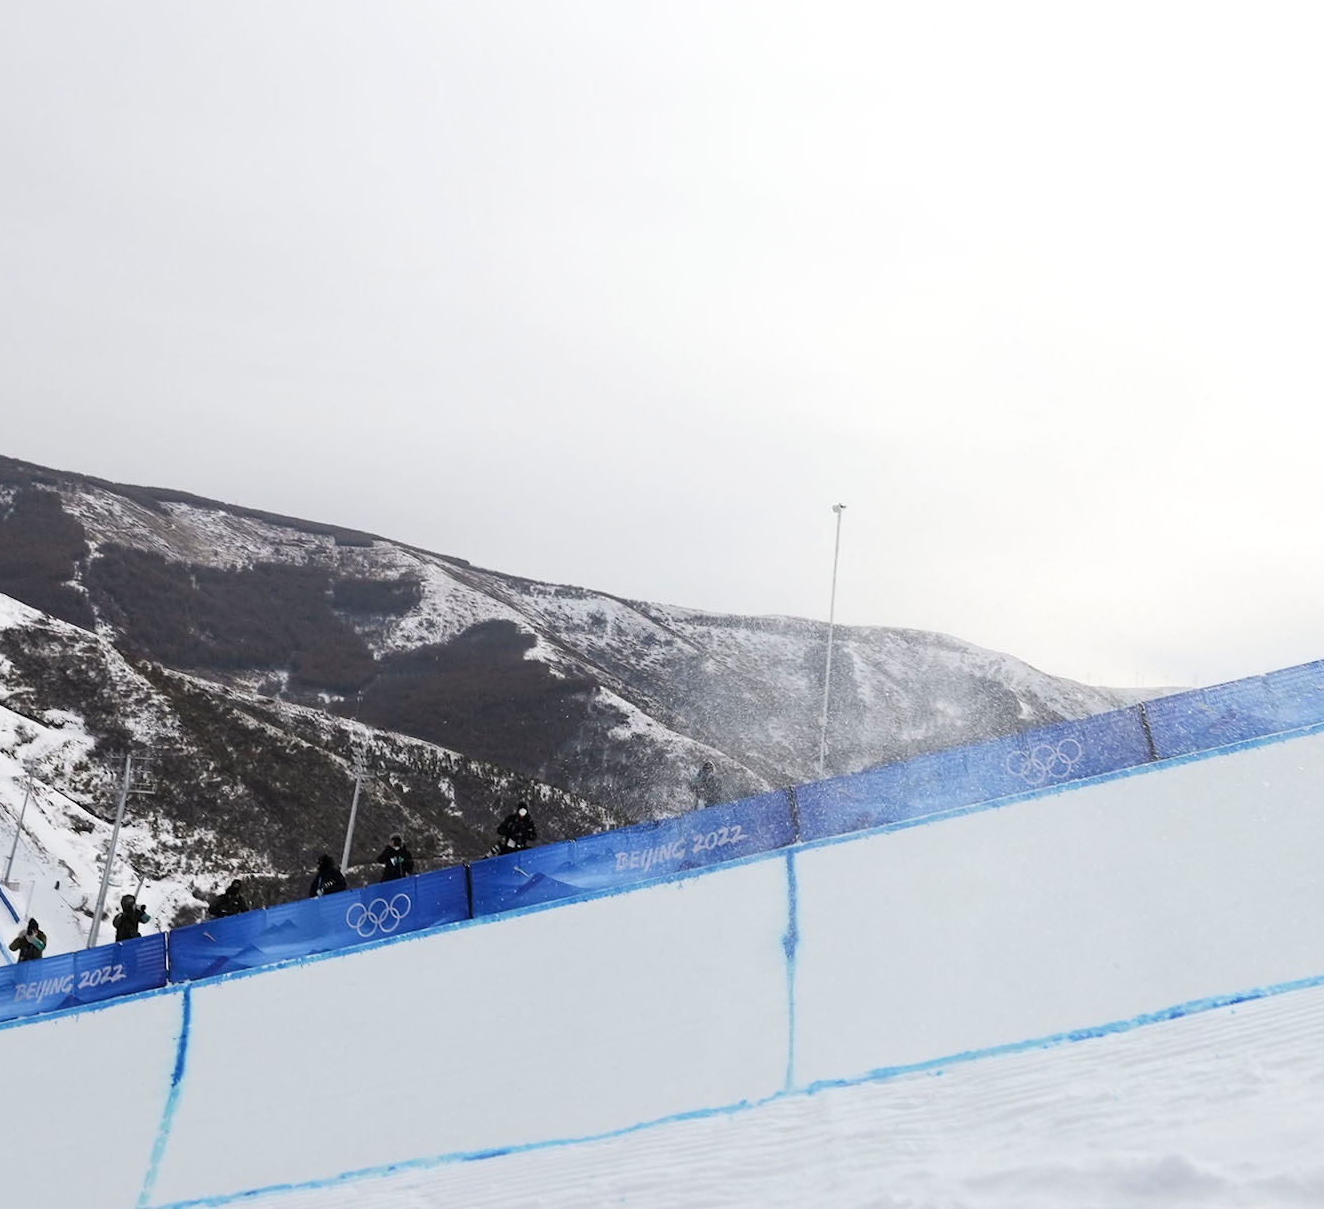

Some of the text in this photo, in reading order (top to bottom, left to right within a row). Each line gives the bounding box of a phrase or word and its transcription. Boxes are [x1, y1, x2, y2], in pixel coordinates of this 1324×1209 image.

[615, 825, 748, 872] BEIJING 2022
[14, 964, 127, 1003] BEIJING 2022
